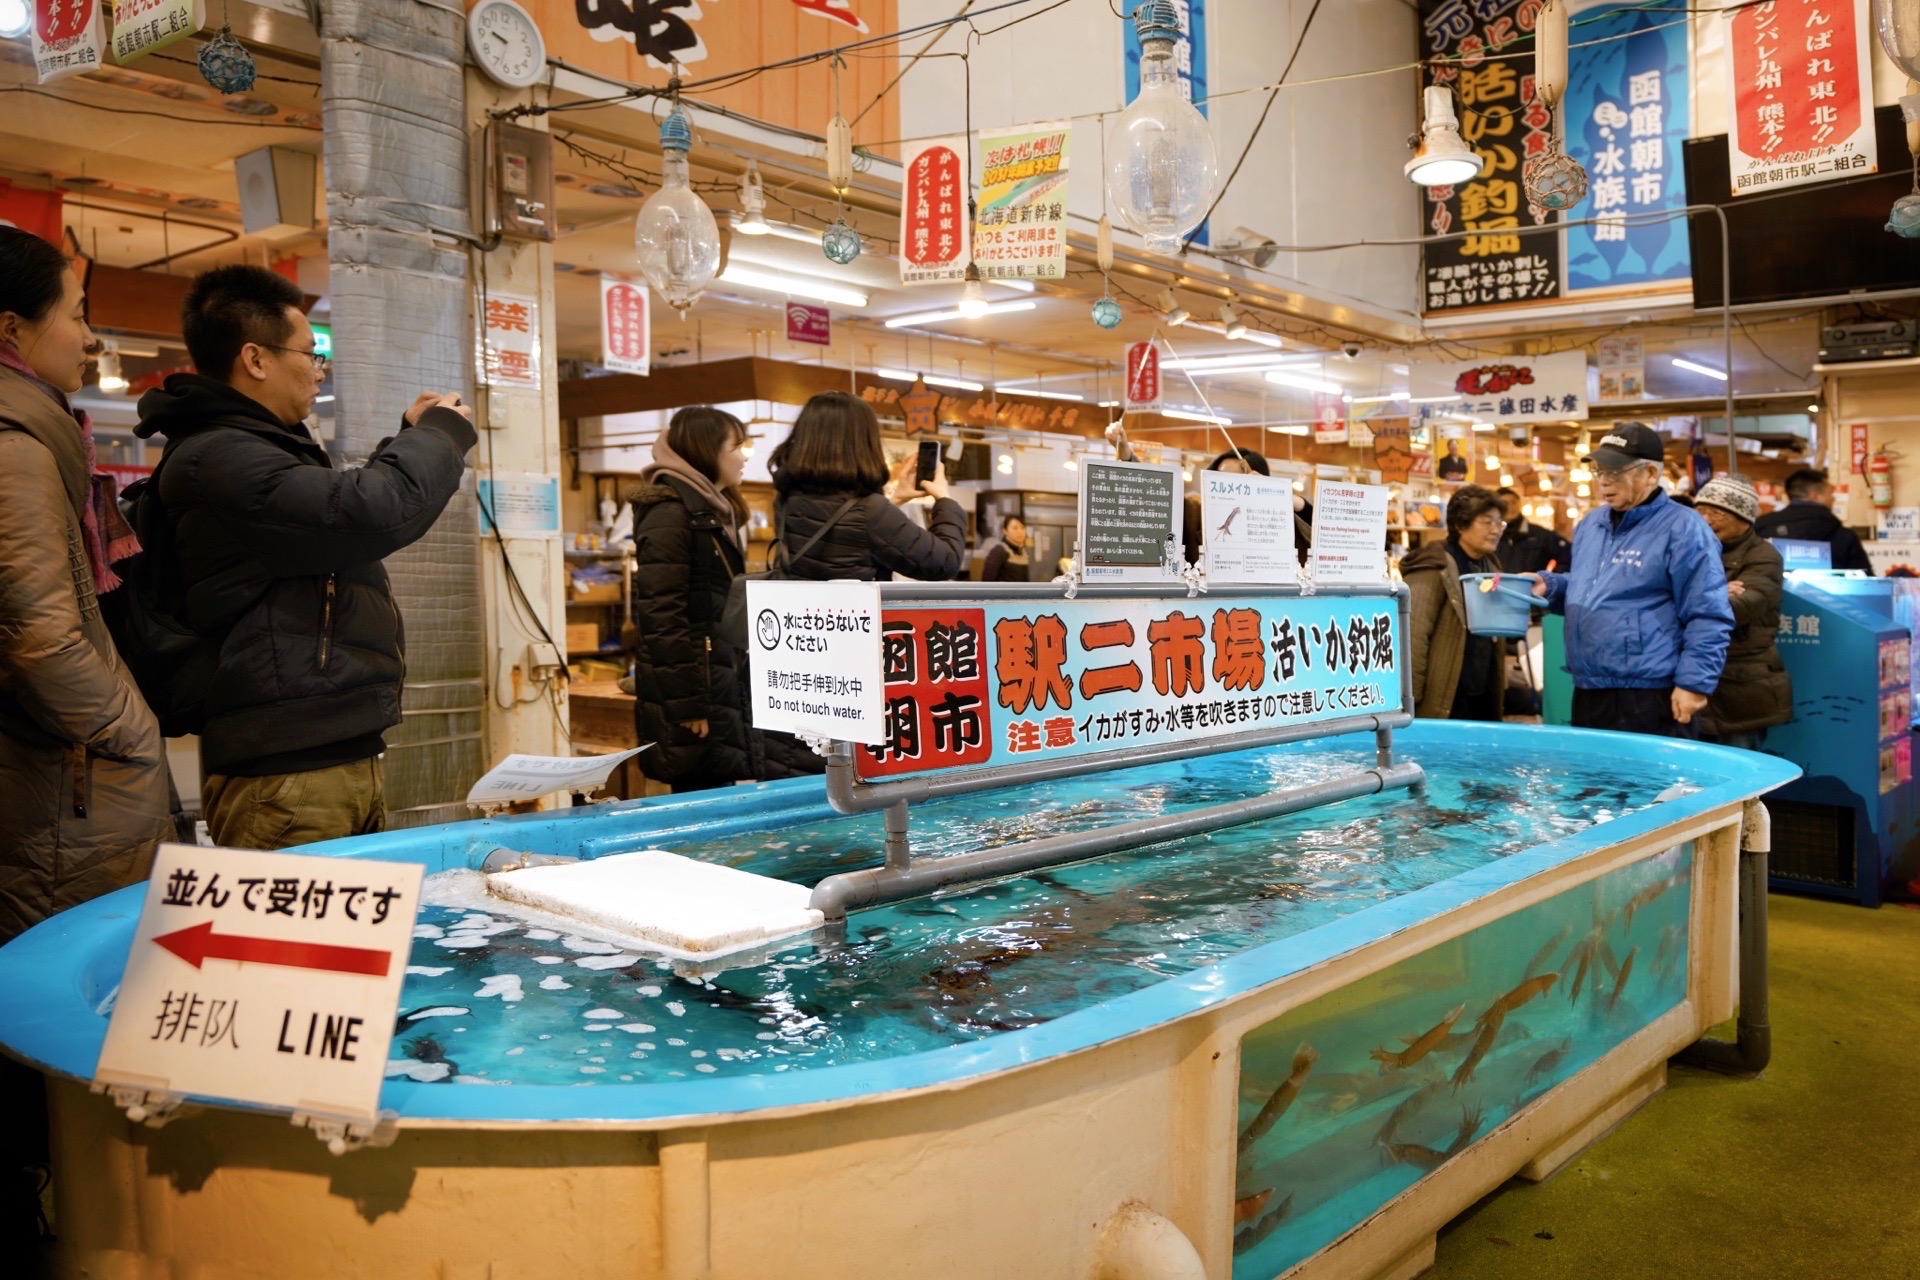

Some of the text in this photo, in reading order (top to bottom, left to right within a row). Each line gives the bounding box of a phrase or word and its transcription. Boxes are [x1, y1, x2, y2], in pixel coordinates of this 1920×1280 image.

[481, 15, 491, 28] 10
[490, 10, 497, 22] 11
[501, 10, 510, 24] 12
[117, 5, 188, 57] 函館朝市駅二組合
[478, 28, 486, 38] 9
[514, 21, 519, 31] 1
[520, 31, 528, 43] 2
[483, 43, 490, 54] 8
[525, 46, 531, 58] 3
[492, 55, 500, 66] 7
[503, 63, 510, 74] 6
[514, 64, 520, 75] 5
[522, 60, 528, 68] 4
[1803, 0, 1838, 143] んばれ東北!!
[1629, 70, 1664, 205] 函館朝市
[985, 133, 1065, 168] 次は札幌!!
[1737, 154, 1867, 189] 函館朝市駅二組合
[938, 151, 953, 259] がんばれ東北!!
[979, 201, 1063, 226] 北海道新幹線
[974, 243, 1061, 260] ありがとうございます!!
[903, 268, 964, 282] 函館朝市駅二組合
[978, 264, 1056, 278] 函館朝市駅二組合
[484, 300, 529, 379] 禁煙
[1210, 481, 1251, 496] スルメイカ
[1886, 520, 1914, 530] Wi-Fi
[784, 612, 871, 633] 水にさわらないで
[785, 634, 828, 652] ください
[881, 619, 979, 686] 函館
[993, 608, 1395, 715] 駅二市場 活いか釣堀
[767, 669, 862, 697] 請勿把手伸到水中
[768, 696, 865, 721] Do not touch water.
[866, 691, 982, 764] 朝市
[1006, 715, 1078, 756] 注意
[161, 868, 402, 925] 並んで受付です
[150, 990, 364, 1062] 排队 LINE
